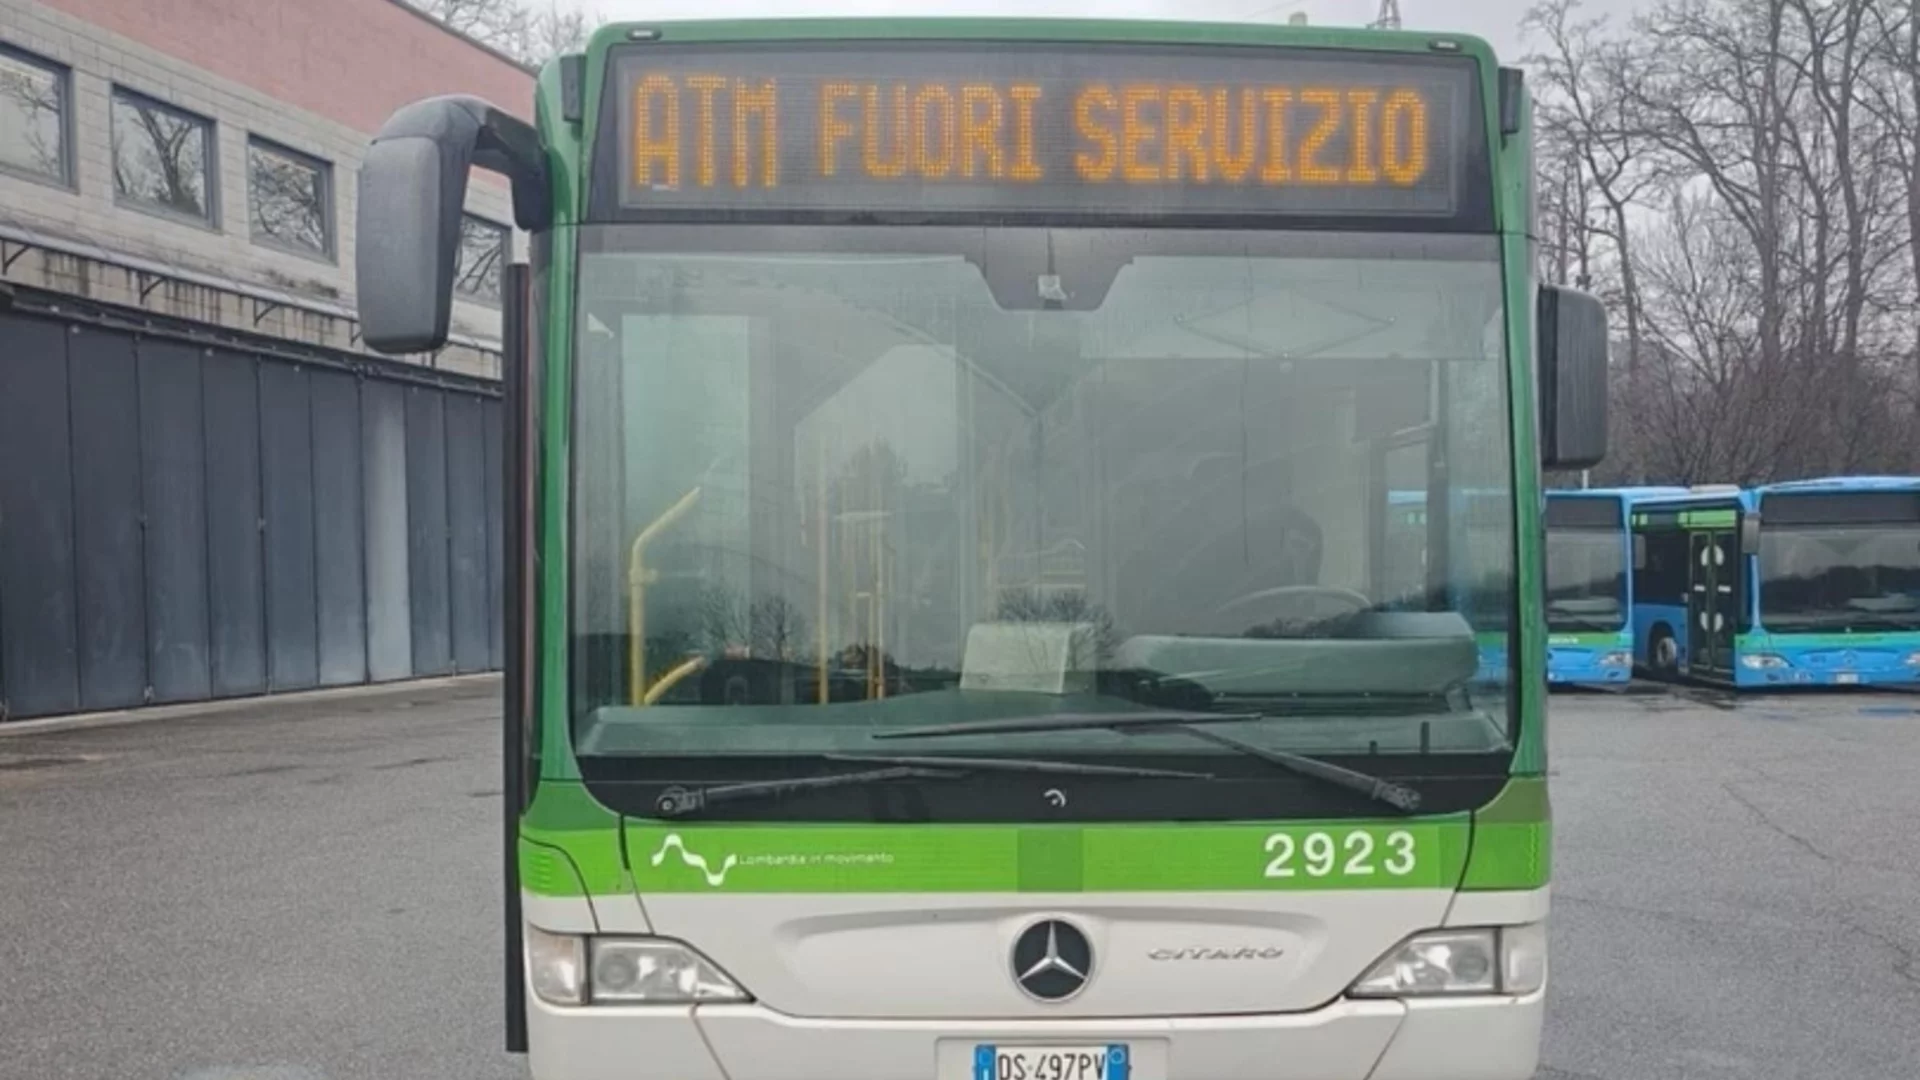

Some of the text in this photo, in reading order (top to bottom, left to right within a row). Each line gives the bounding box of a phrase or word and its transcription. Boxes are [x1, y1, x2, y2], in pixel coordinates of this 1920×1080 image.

[637, 75, 1428, 187] ATM FUORI SERVIZIO
[1263, 830, 1417, 878] 2923
[1147, 947, 1284, 960] CITARO
